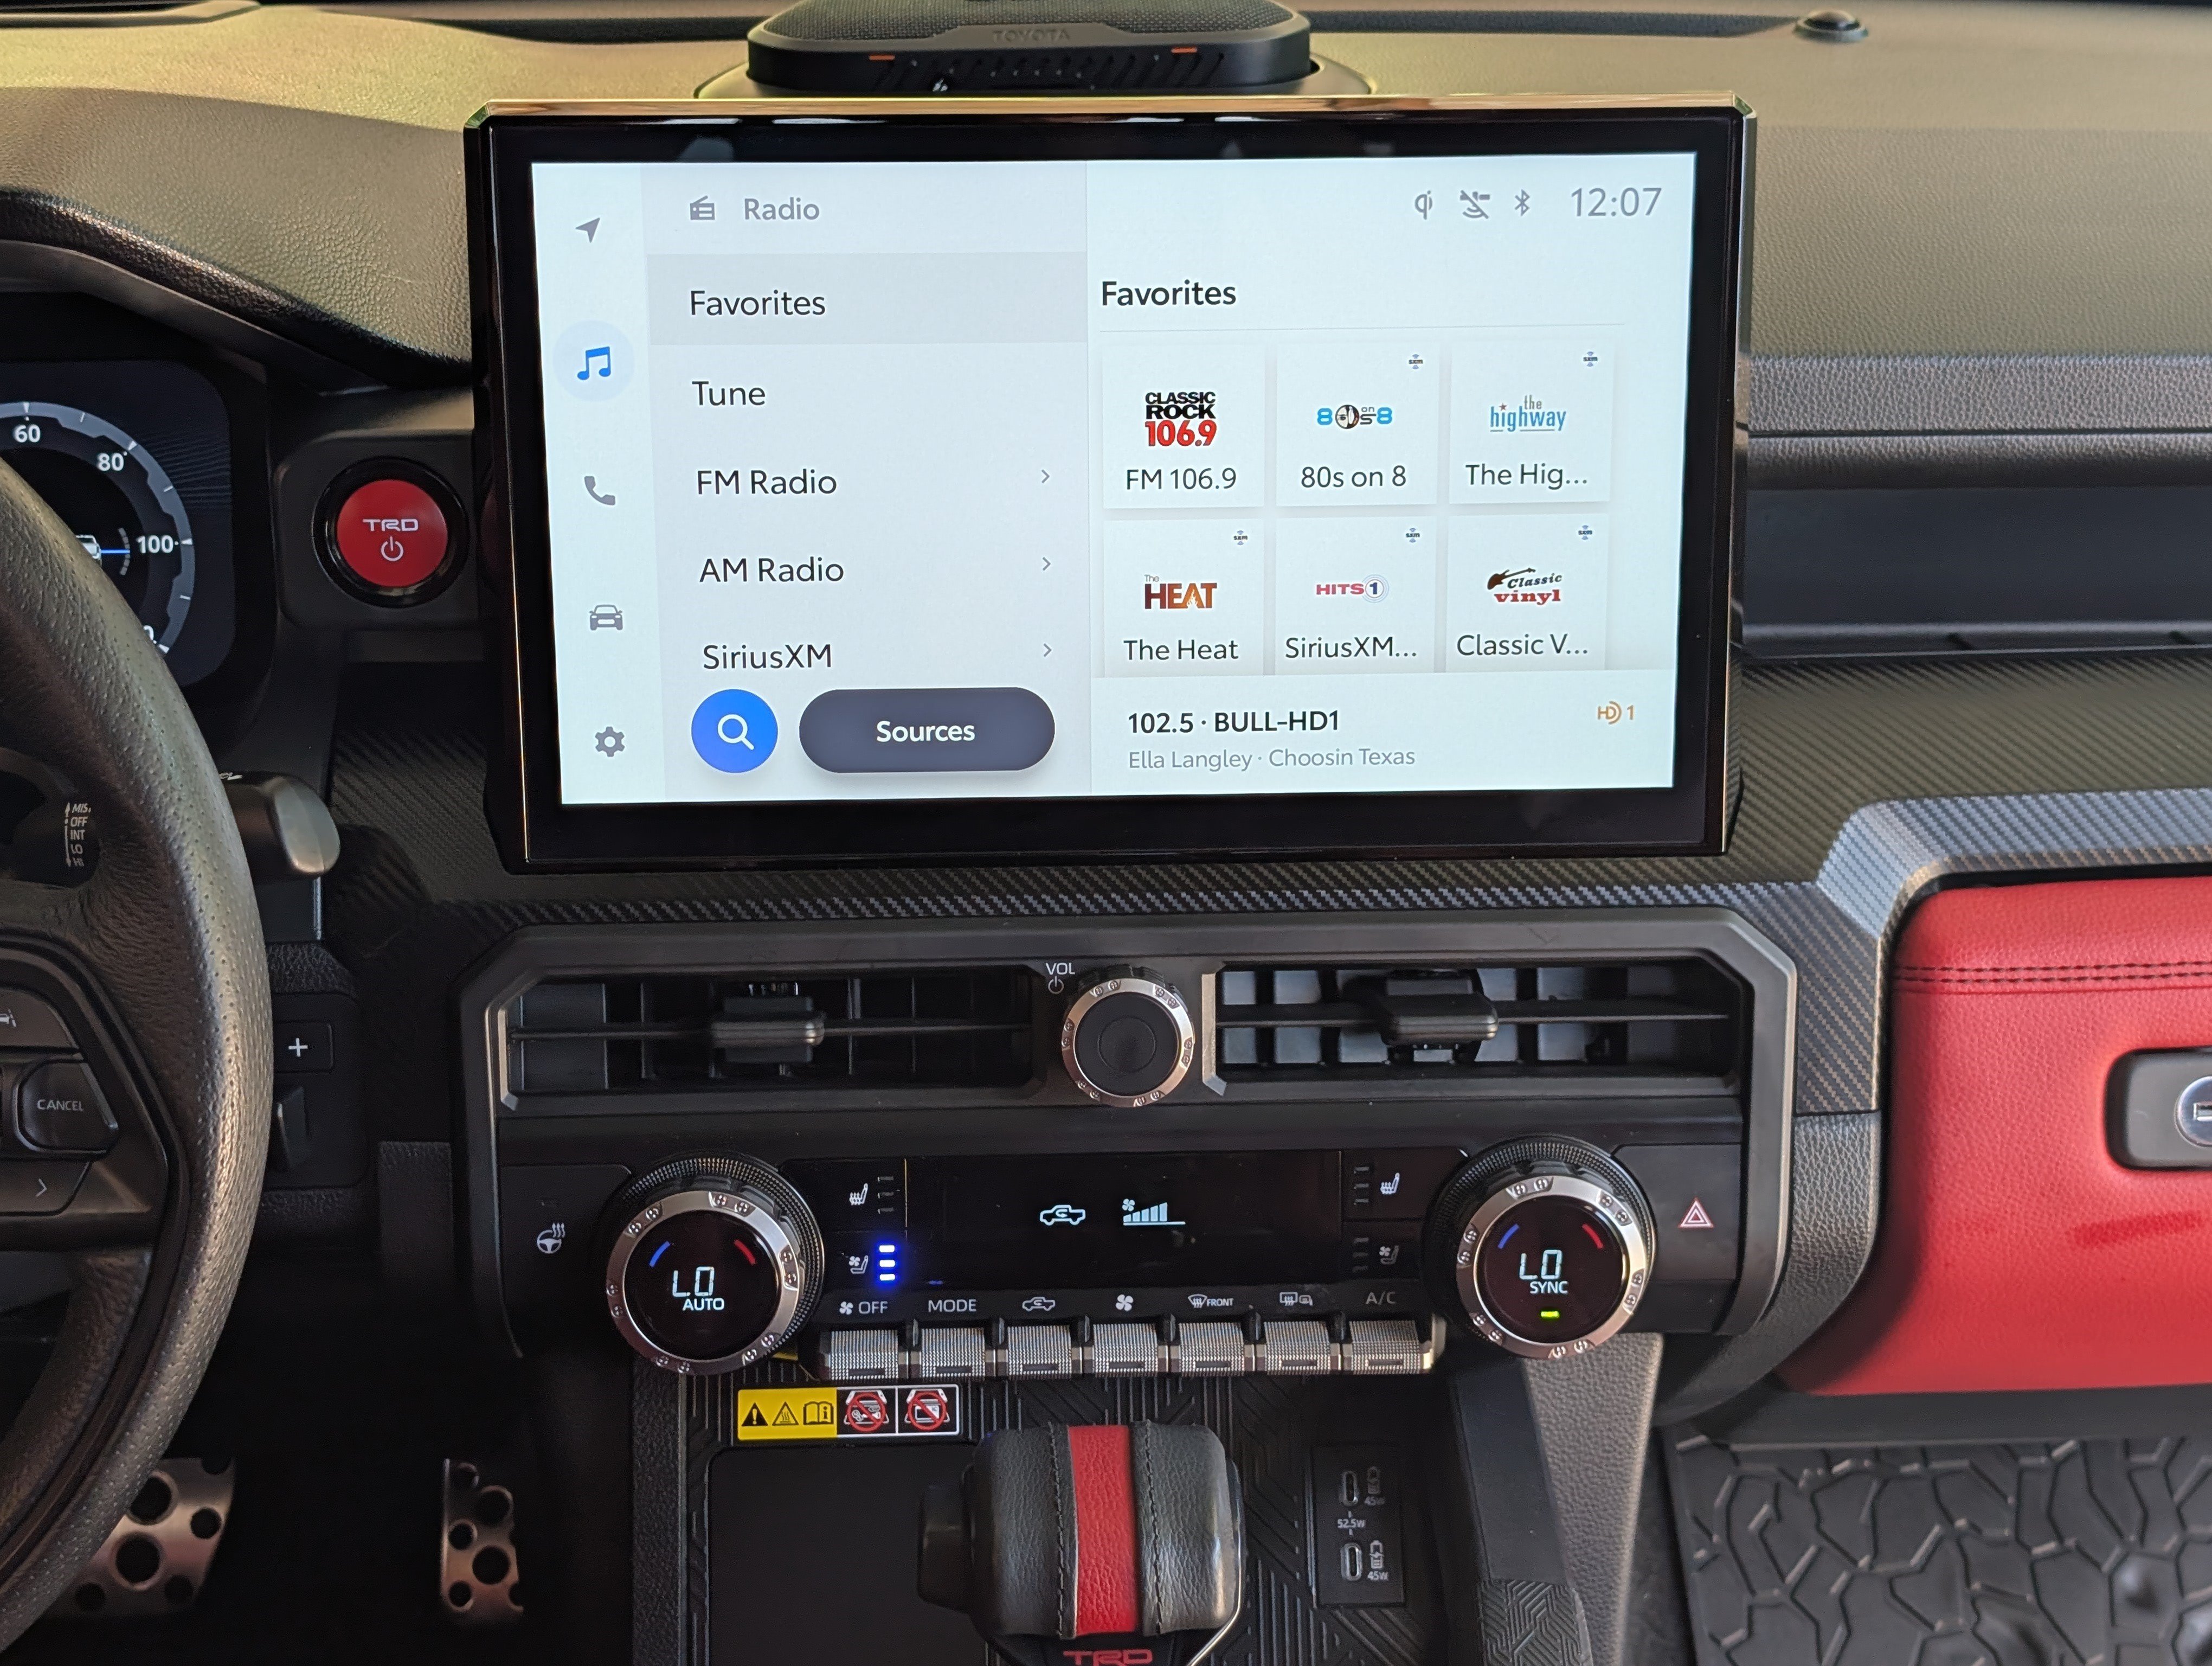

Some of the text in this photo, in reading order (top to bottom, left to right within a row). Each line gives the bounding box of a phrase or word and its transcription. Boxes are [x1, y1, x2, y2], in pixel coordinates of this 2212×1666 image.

[992, 28, 1070, 42] TOYOTA
[745, 197, 819, 220] Radio
[1572, 188, 1662, 216] 12:07
[1103, 279, 1236, 306] Favorites
[691, 290, 825, 315] Favorites
[692, 381, 765, 406] Tune
[1146, 392, 1216, 404] CLASSIC
[1525, 395, 1542, 409] the
[1146, 404, 1216, 419] ROCK
[1377, 407, 1392, 424] 8
[1490, 406, 1566, 432] highway
[14, 424, 40, 443] 60
[1145, 420, 1217, 446] 106.9
[98, 452, 124, 471] 80
[698, 469, 837, 494] FM Radio
[1127, 468, 1236, 490] FM 106.9
[1302, 465, 1406, 488] 80s on 8
[1465, 464, 1512, 485] The
[363, 519, 418, 531] TRD
[138, 535, 173, 553] 100
[700, 556, 844, 582] AM Radio
[1316, 582, 1377, 595] HITS 1
[1507, 573, 1562, 588] Classic
[1145, 583, 1217, 609] HEAT
[1494, 589, 1560, 605] vinyl
[1124, 639, 1238, 660] The Heat
[1457, 634, 1543, 655] Classic
[704, 644, 831, 669] SiriusXM
[1627, 705, 1634, 720] 1
[1129, 713, 1193, 733] 102.5
[1216, 710, 1337, 732] BULL-HD1
[876, 720, 975, 742] Sources
[1130, 751, 1164, 768] Ella
[1172, 749, 1252, 772] Langley
[1269, 748, 1353, 766] Choosin
[1359, 748, 1414, 765] Texas
[72, 803, 91, 813] MIS
[70, 817, 88, 827] OFF
[70, 829, 85, 840] INT
[70, 844, 83, 854] LO
[1046, 963, 1075, 975] VOL
[37, 1099, 83, 1111] CANCEL
[1530, 1281, 1567, 1294] SYNC
[683, 1298, 724, 1310] AUTO
[859, 1301, 888, 1313] OFF
[928, 1299, 976, 1312] MODE
[1207, 1298, 1233, 1306] FRONT
[1366, 1292, 1395, 1305] A/C
[1368, 1571, 1388, 1580] 45W
[1063, 1649, 1153, 1666] TRD
